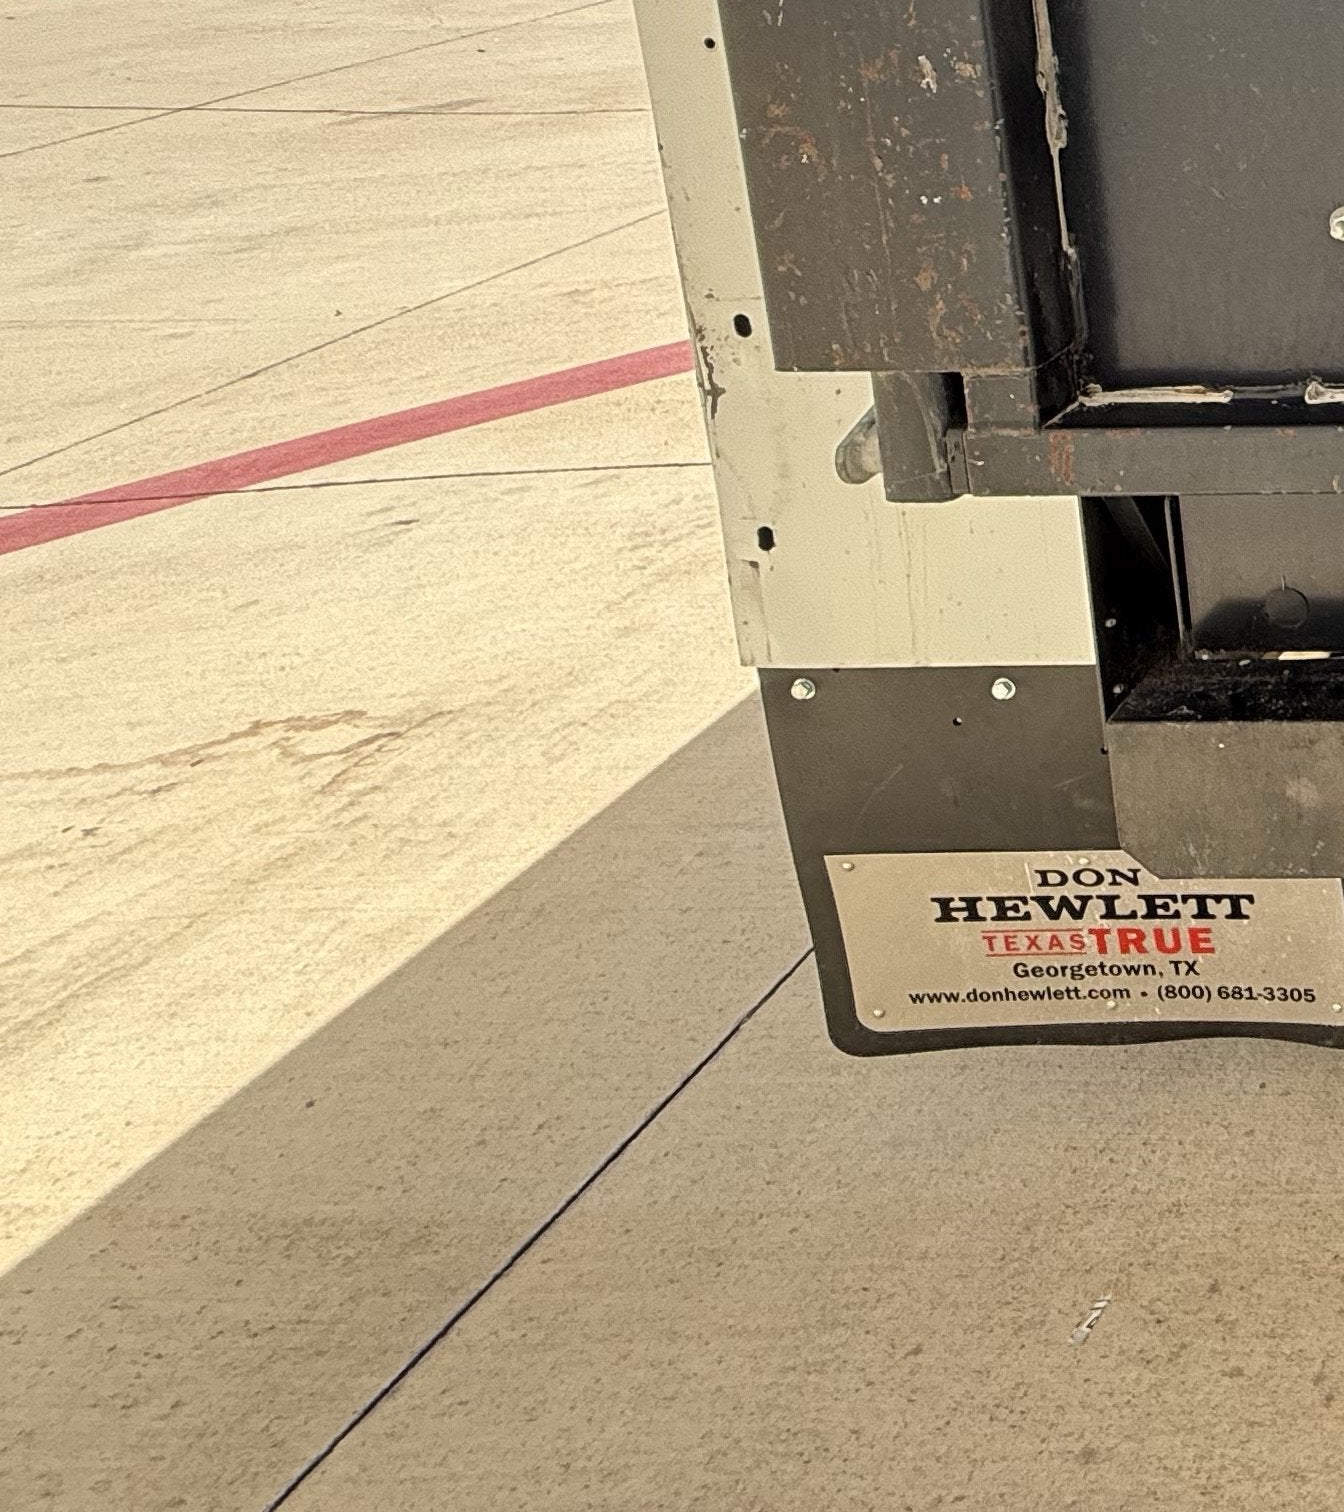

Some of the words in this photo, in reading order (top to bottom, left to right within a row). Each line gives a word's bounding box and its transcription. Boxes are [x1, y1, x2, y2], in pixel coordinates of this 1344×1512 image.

[1034, 868, 1141, 887] DON
[930, 894, 1255, 923] HEWLETT
[1013, 960, 1163, 980] Georgetown,
[1169, 960, 1200, 977] TX
[909, 986, 1131, 1004] www.donhewlett.com
[1157, 984, 1212, 1003] (800)
[1217, 984, 1316, 1003] 681-3305
